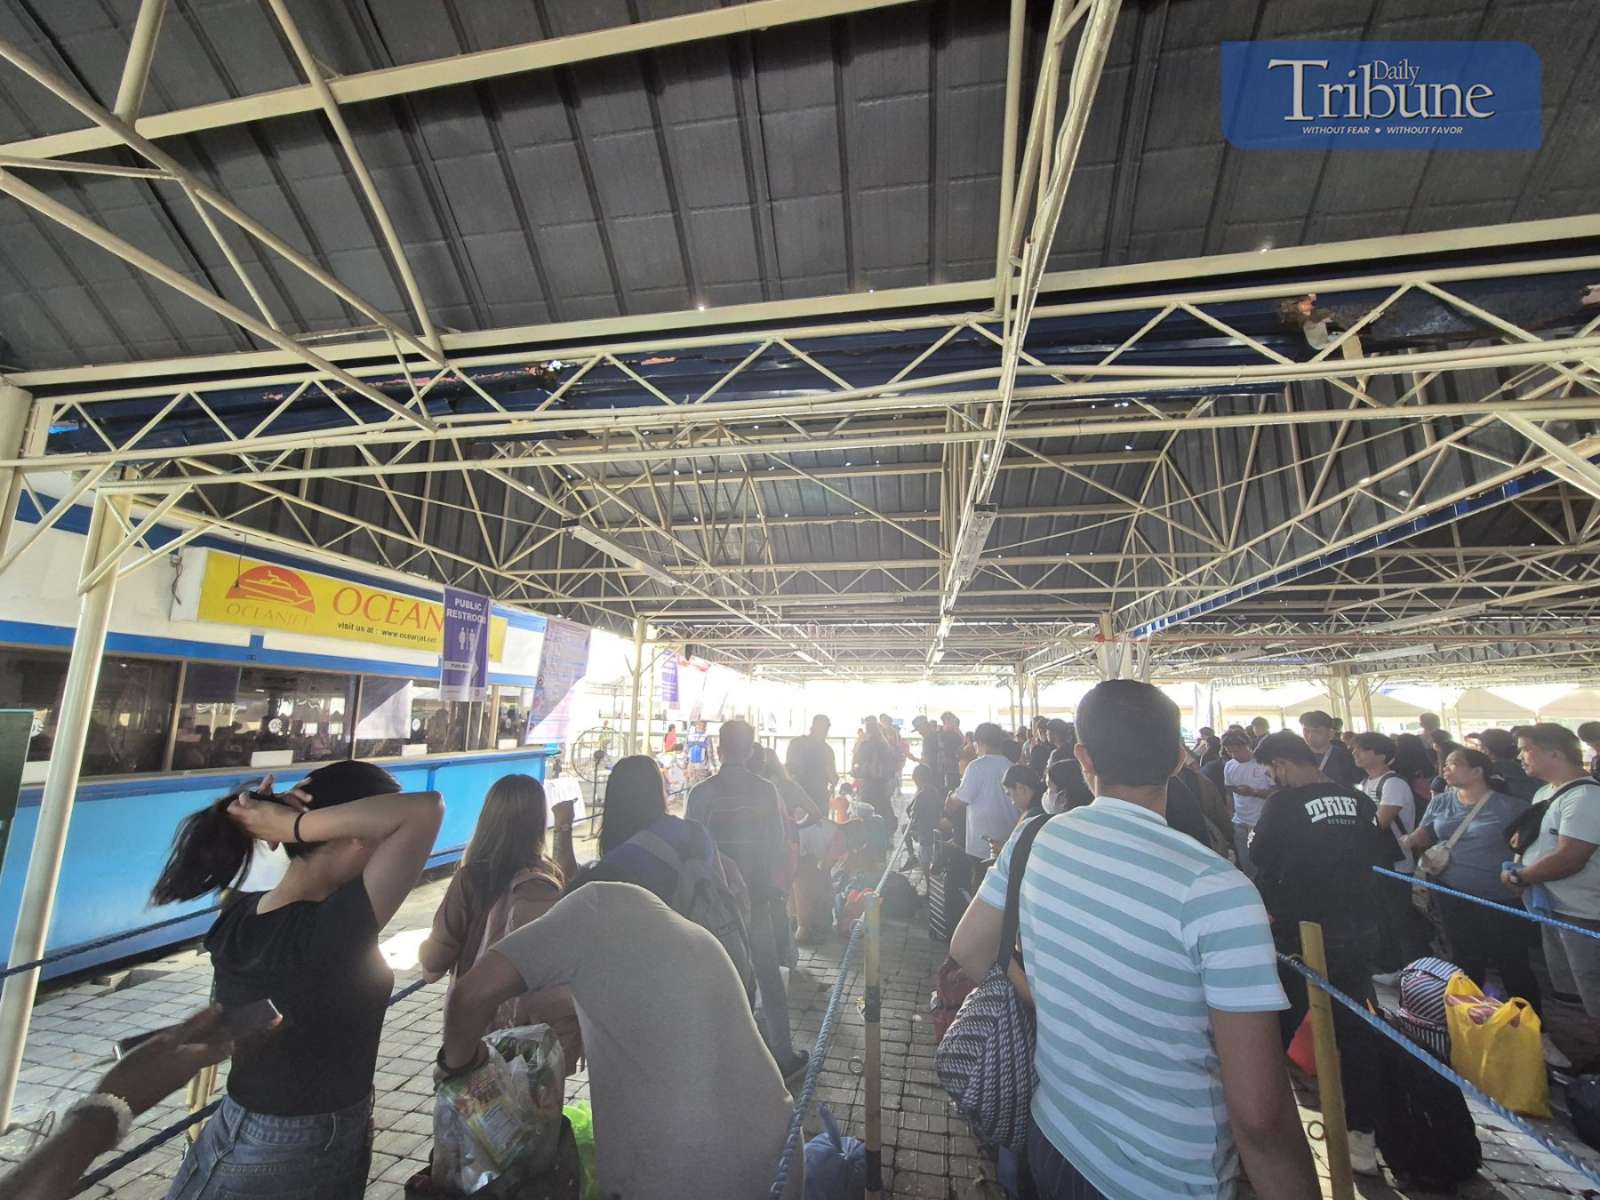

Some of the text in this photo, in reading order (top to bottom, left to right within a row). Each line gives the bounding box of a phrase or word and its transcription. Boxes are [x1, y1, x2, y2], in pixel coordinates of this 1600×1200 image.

[333, 586, 444, 633] OCEAN
[454, 598, 482, 612] PUBLIC
[337, 621, 354, 631] visit
[355, 625, 365, 633] us
